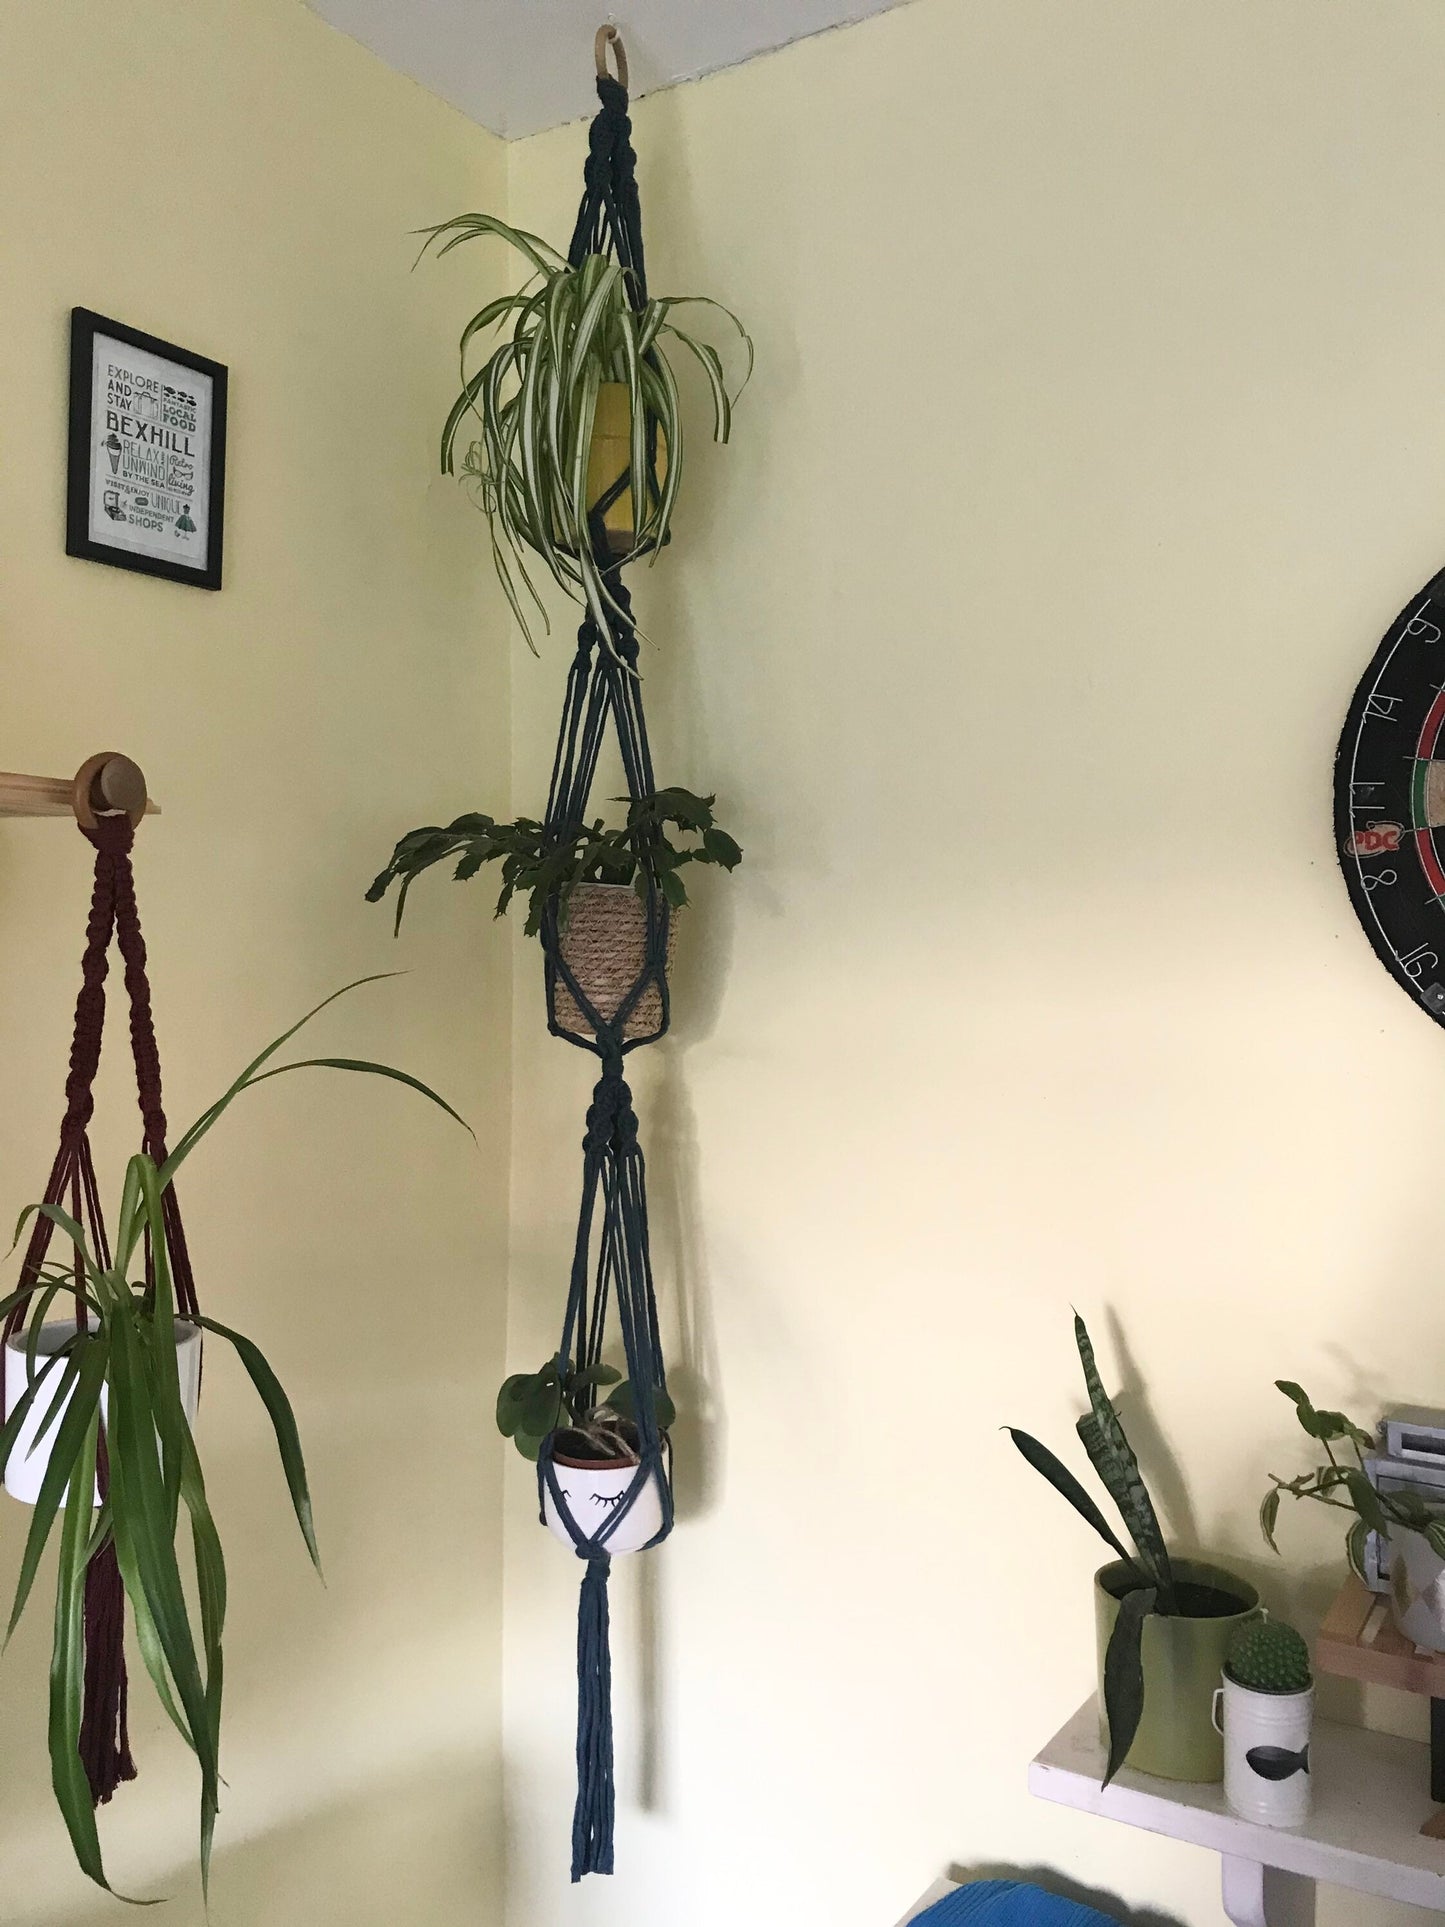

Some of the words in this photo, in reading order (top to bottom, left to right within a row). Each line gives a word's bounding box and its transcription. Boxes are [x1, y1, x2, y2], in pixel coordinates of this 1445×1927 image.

[108, 364, 159, 393] EXPLORE
[108, 379, 132, 396] AND
[107, 393, 132, 411] STAY
[163, 404, 197, 422] LOCAL
[163, 413, 196, 432] FOOD
[106, 410, 195, 457] BEXHILL
[123, 439, 159, 465] RELAX
[122, 454, 165, 481] UNWIND
[169, 455, 194, 470] Retro
[122, 470, 133, 478] BY
[135, 474, 149, 484] THE
[151, 479, 165, 488] SEA
[130, 487, 150, 497] ENJOY
[128, 513, 163, 533] SHOPS
[129, 505, 175, 523] INDEPENDENT
[1407, 617, 1441, 643] 9
[1362, 693, 1403, 724] 14
[1351, 830, 1400, 851] PDC
[1360, 869, 1398, 891] 8
[1395, 942, 1439, 978] 16
